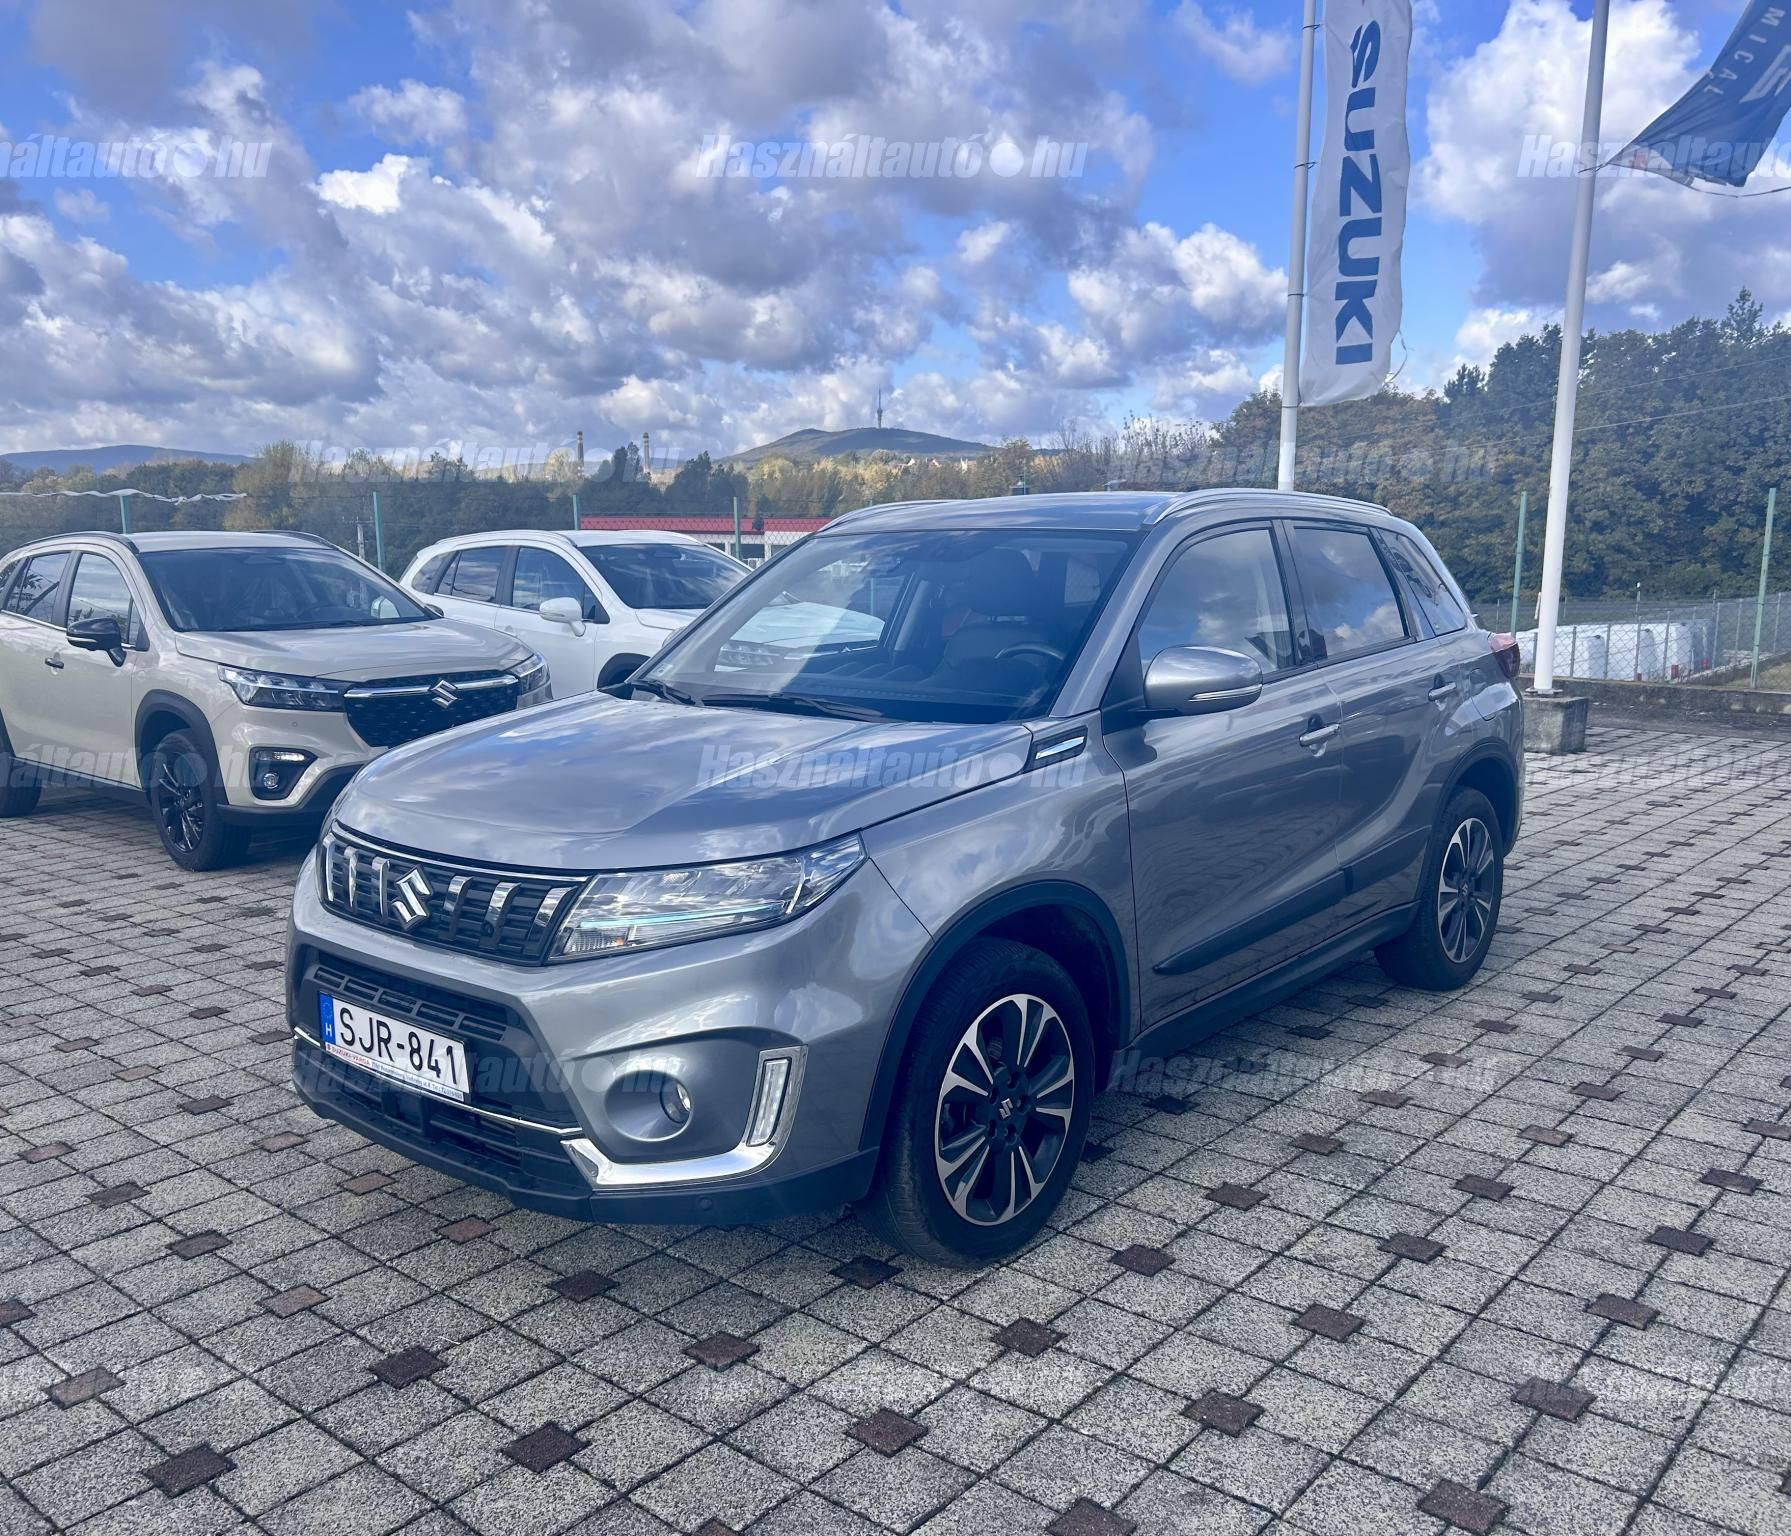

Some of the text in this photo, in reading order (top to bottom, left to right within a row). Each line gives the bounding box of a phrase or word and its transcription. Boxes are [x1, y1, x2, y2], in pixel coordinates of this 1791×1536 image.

[1336, 20, 1383, 365] SUZUKI
[325, 1022, 333, 1037] H
[340, 1007, 458, 1085] SJR-841
